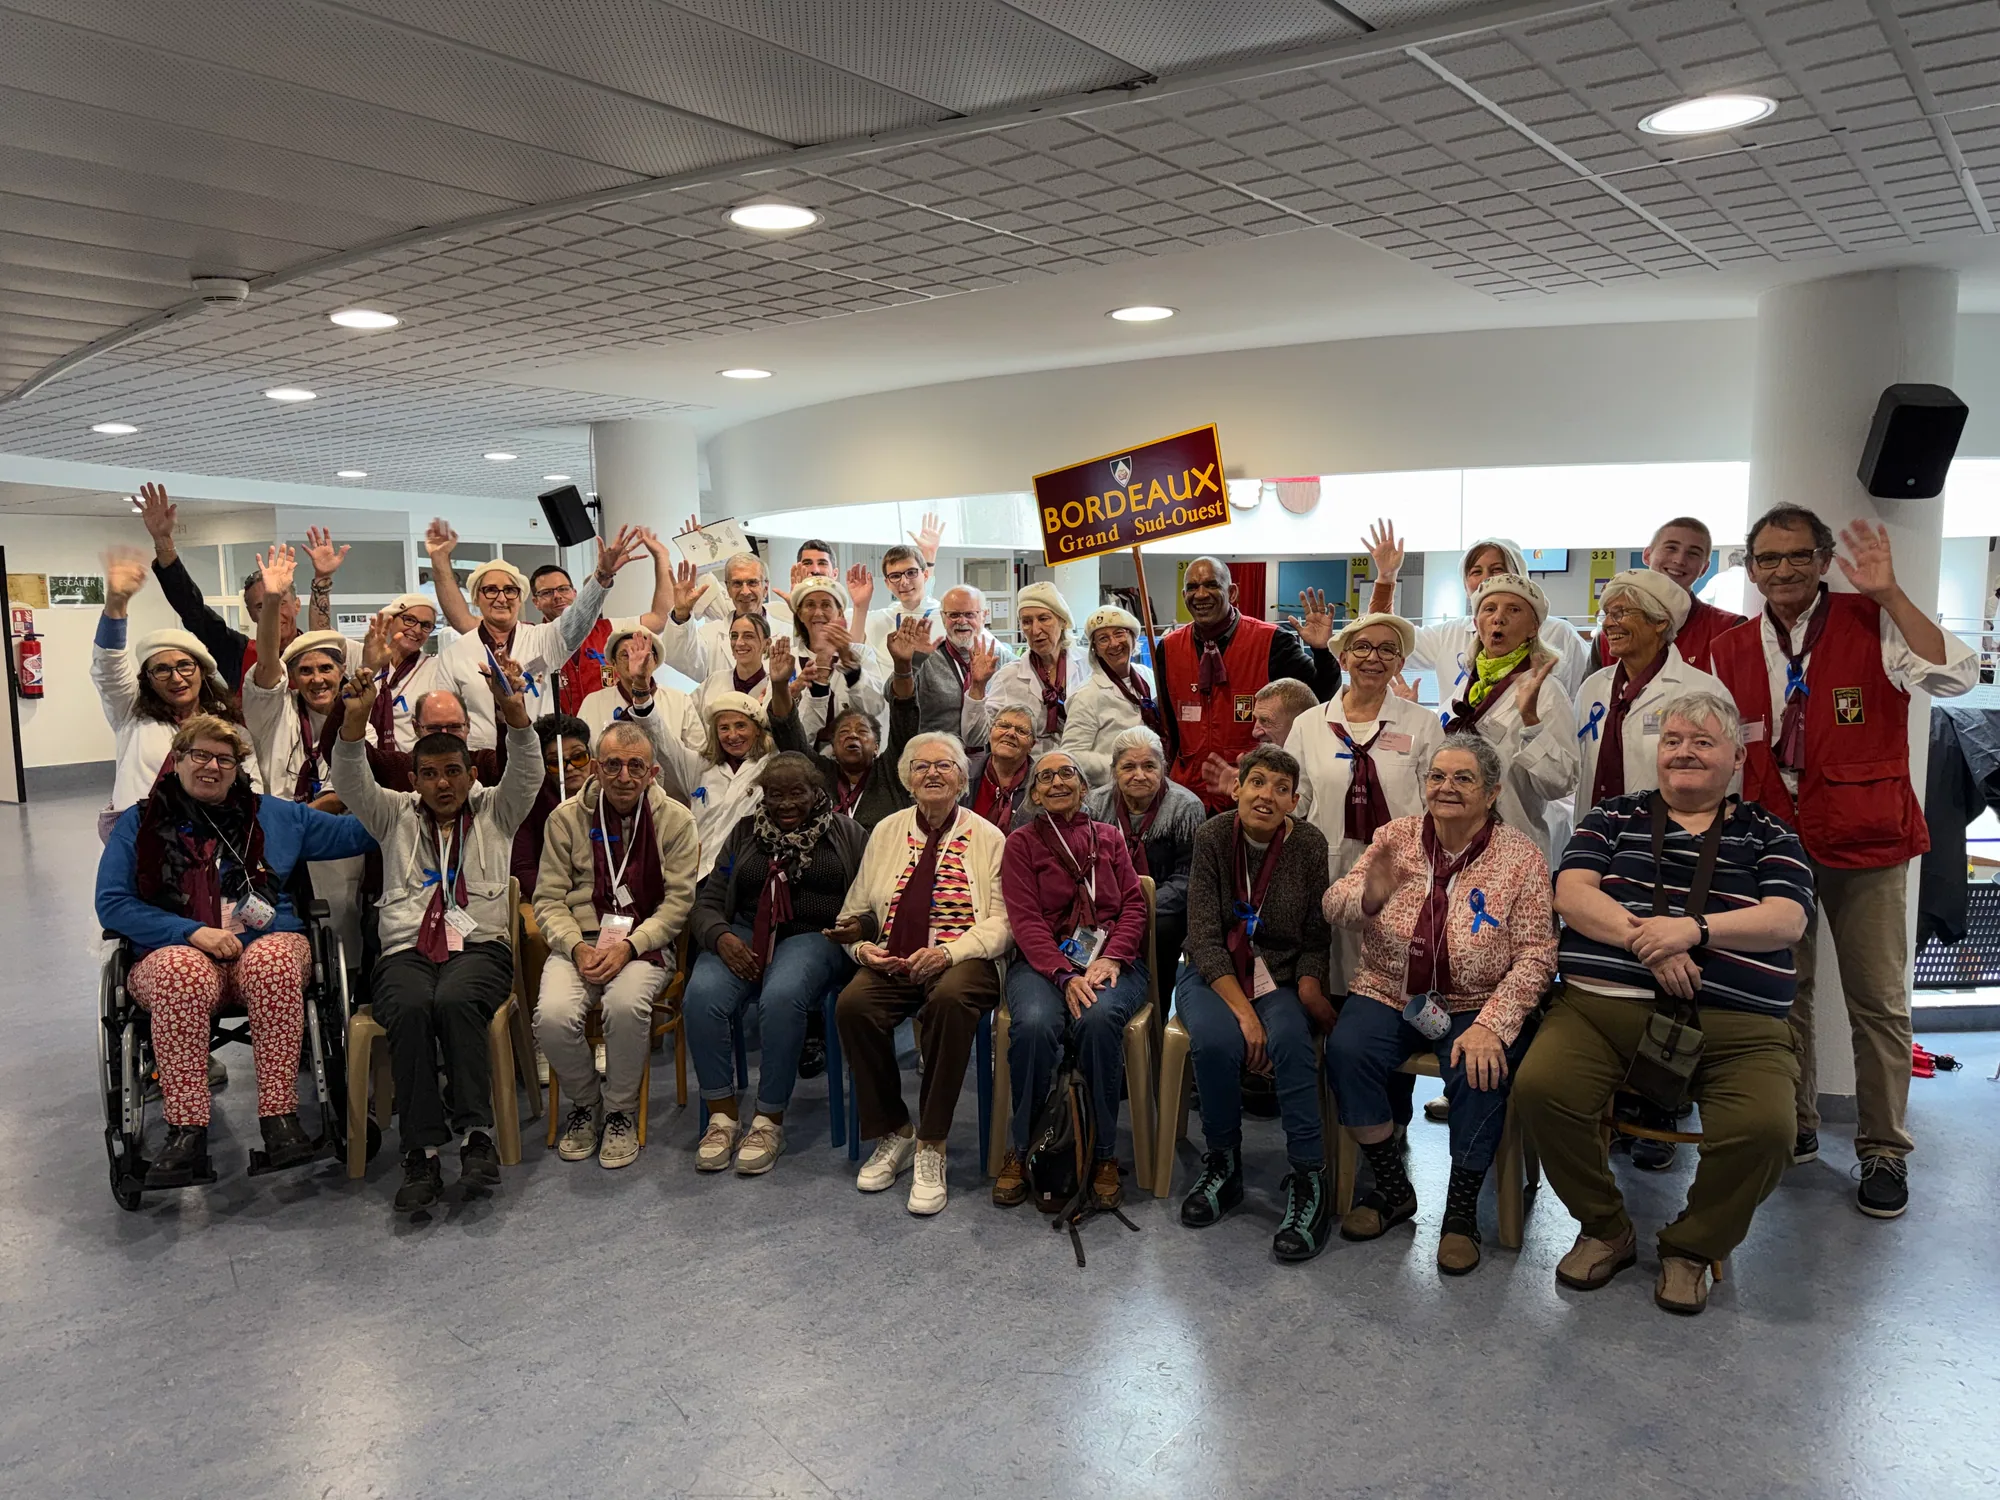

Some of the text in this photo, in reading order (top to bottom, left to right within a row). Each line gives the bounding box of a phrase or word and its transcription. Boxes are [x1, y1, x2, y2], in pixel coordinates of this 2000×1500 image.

[1044, 463, 1219, 534] BORDEAUX
[1059, 500, 1223, 553] Grand Sud-Ouest
[1592, 551, 1614, 560] 321
[1352, 558, 1368, 567] 320
[58, 579, 96, 588] ESCALIER
